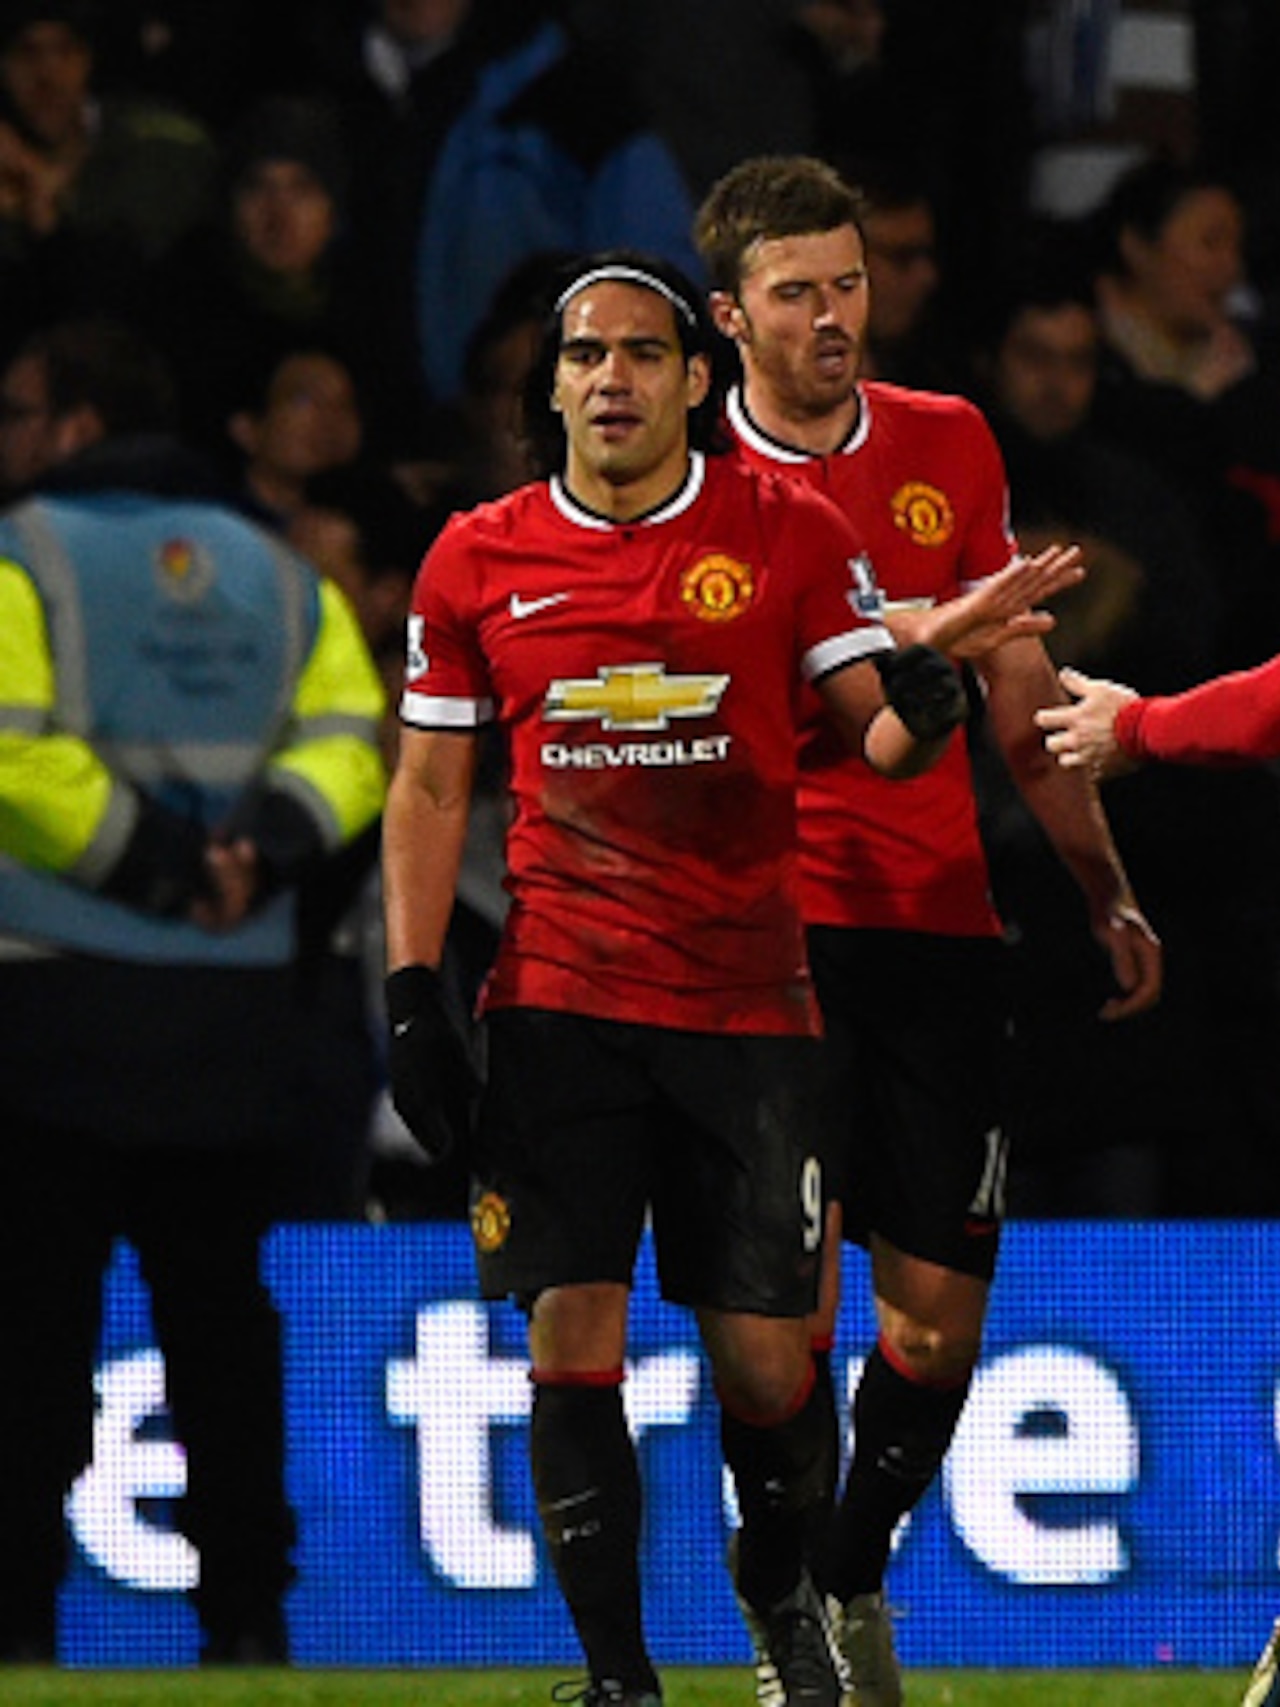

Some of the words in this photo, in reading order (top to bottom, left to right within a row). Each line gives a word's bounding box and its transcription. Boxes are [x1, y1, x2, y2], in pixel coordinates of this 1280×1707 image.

[540, 735, 732, 769] CHEVROLET
[803, 1156, 821, 1252] 9
[384, 1300, 1140, 1588] te
